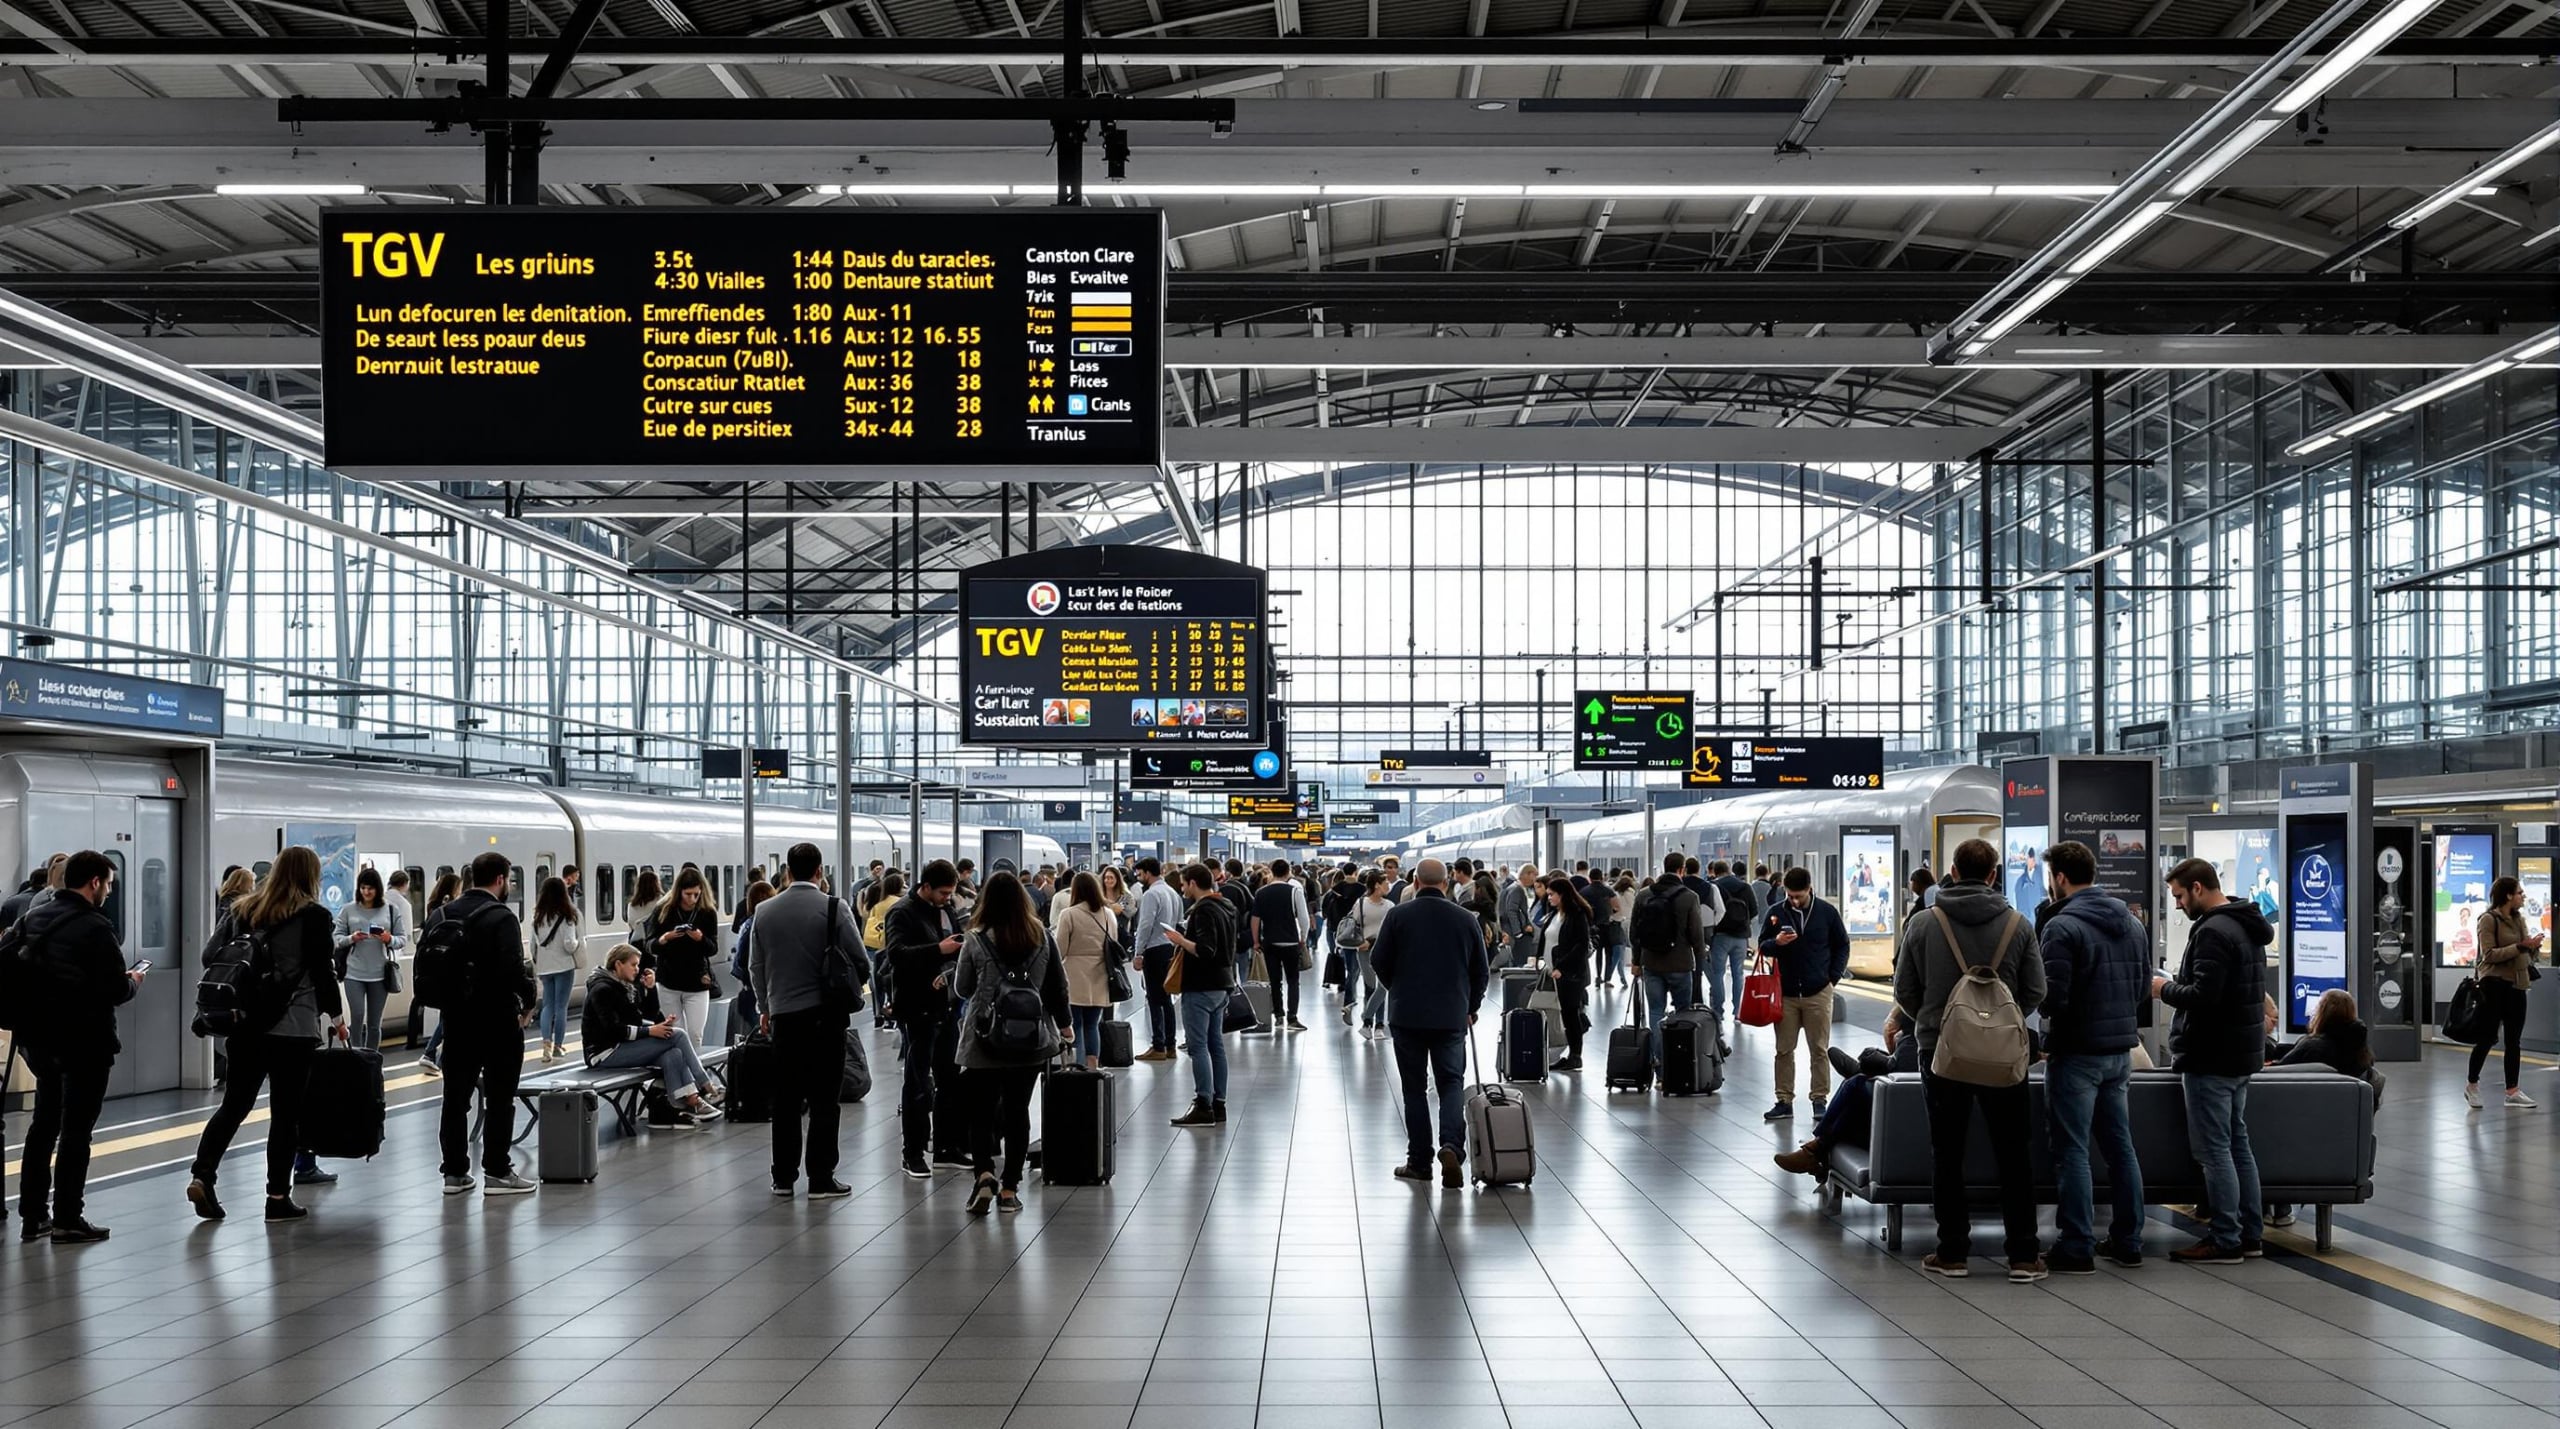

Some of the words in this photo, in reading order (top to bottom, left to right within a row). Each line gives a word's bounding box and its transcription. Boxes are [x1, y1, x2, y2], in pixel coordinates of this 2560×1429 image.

[342, 231, 446, 278] TGV
[476, 252, 515, 276] Les
[792, 250, 834, 268] 1:44
[890, 249, 915, 268] du
[1025, 247, 1090, 263] Canston
[654, 271, 699, 290] 4:30
[793, 271, 833, 290] 1:00
[843, 270, 922, 290] Dentaure
[356, 303, 393, 323] Lun
[398, 302, 497, 323] defocuren
[530, 303, 632, 323] denitation.
[792, 303, 833, 321] 1:80
[356, 328, 381, 348] De
[442, 328, 480, 348] less
[484, 333, 537, 352] poaur
[541, 328, 586, 348] deus
[642, 350, 727, 371] Corpacun
[957, 349, 981, 369] 18
[956, 373, 982, 391] 38
[699, 400, 730, 415] sur
[732, 400, 773, 415] cues
[956, 396, 982, 415] 38
[642, 419, 678, 438] Eue
[682, 418, 707, 438] de
[956, 419, 983, 438] 28
[1095, 599, 1116, 611] des
[1119, 599, 1135, 611] de
[975, 627, 1045, 657] TGV
